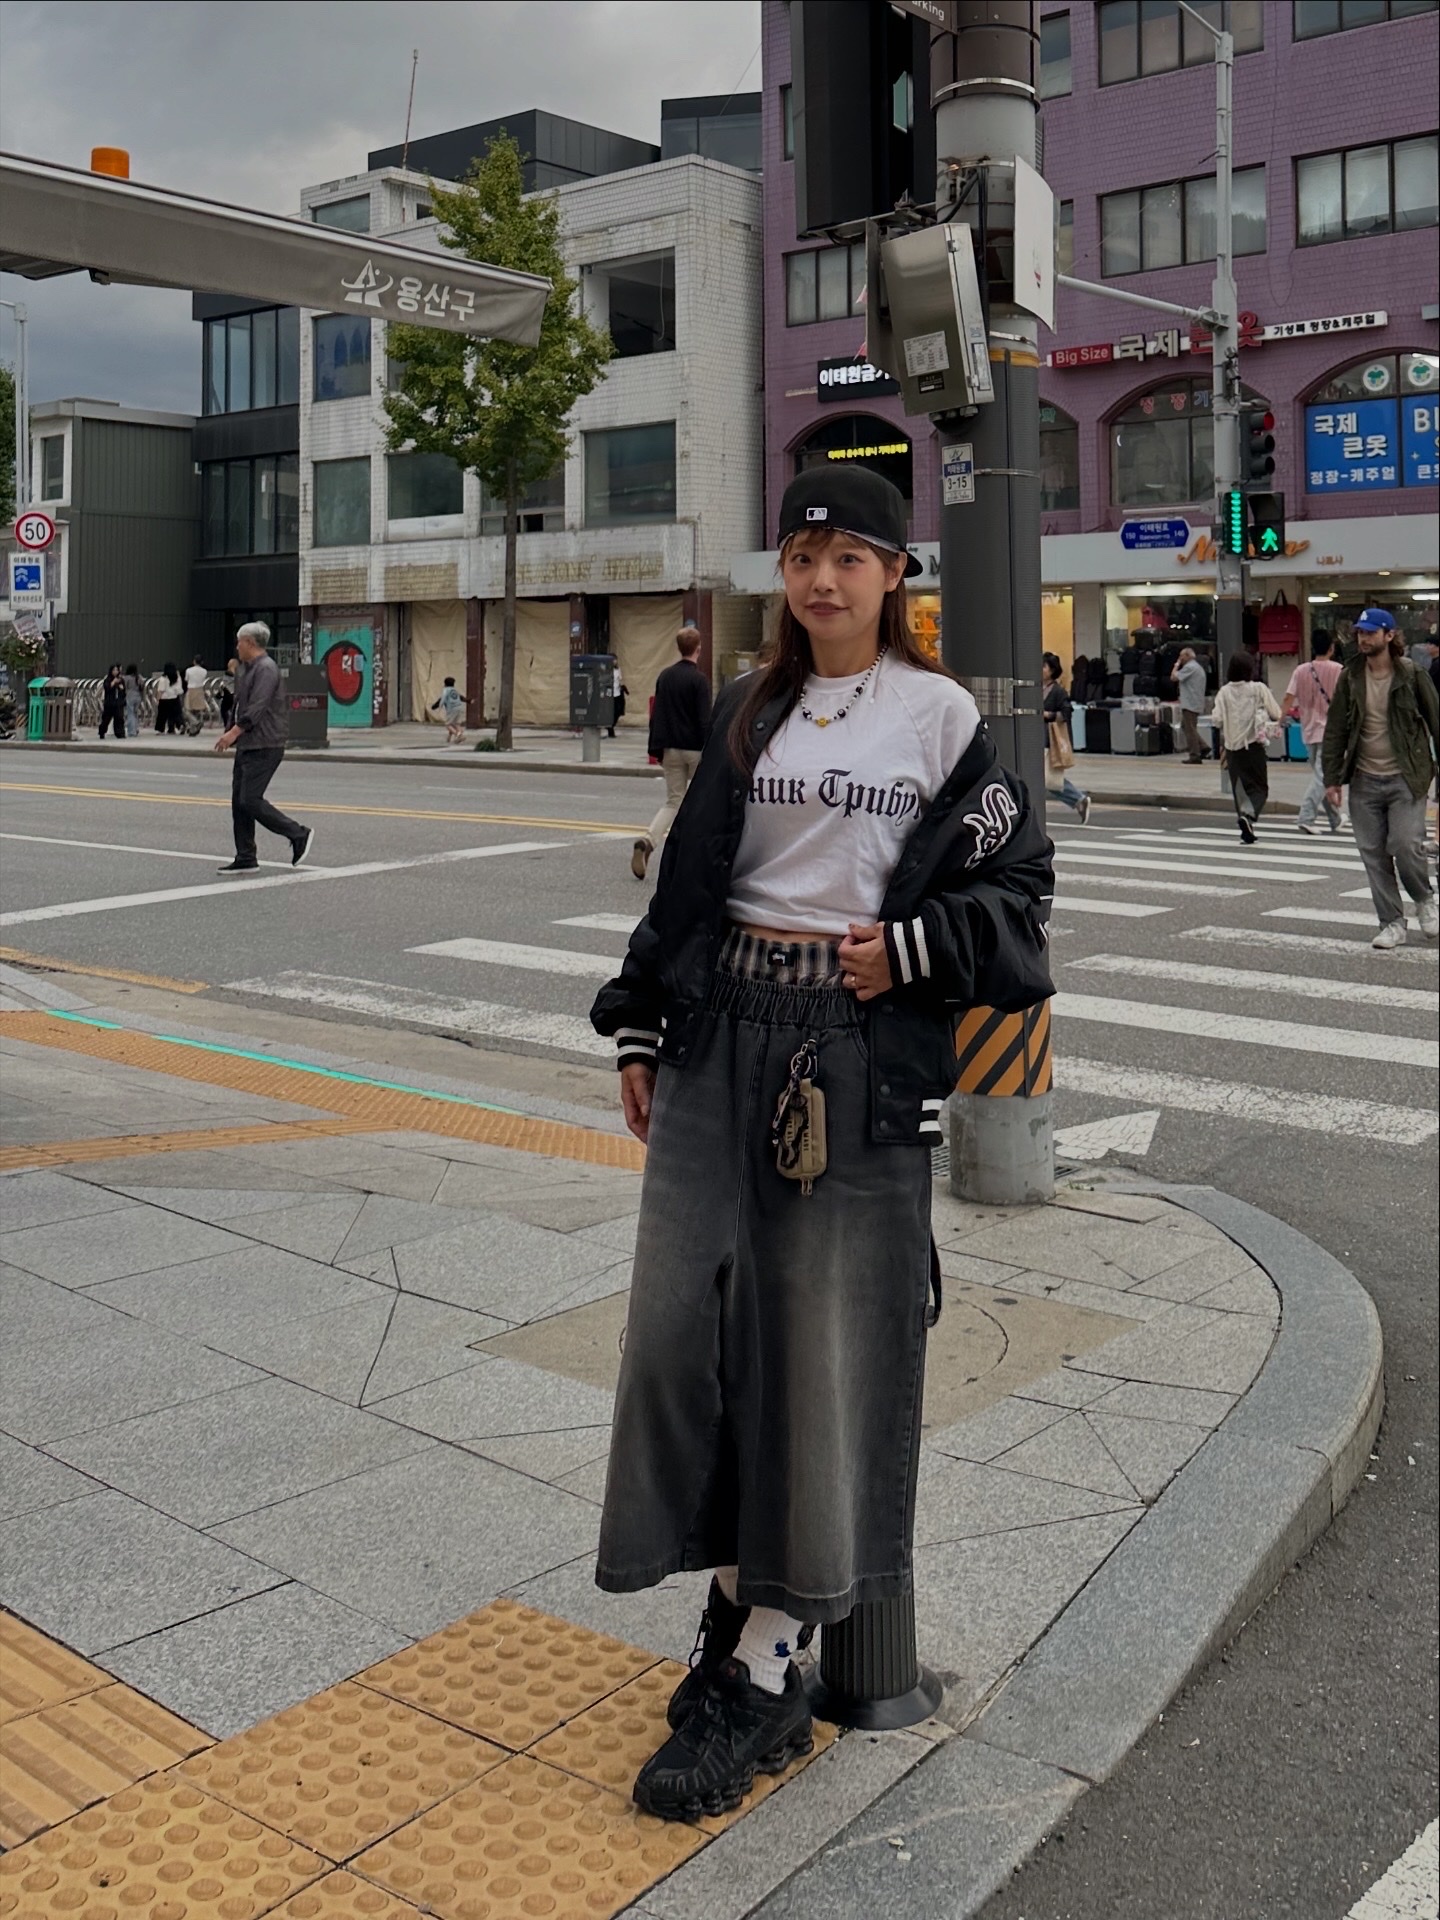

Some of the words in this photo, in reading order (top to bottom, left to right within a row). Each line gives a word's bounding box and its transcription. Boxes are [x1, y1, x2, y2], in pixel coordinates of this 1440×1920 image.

[397, 276, 476, 321] 용산구
[1119, 329, 1180, 361] 국제
[1055, 351, 1078, 366] Big
[1080, 347, 1109, 361] Size
[1314, 412, 1358, 435] 국제
[1343, 434, 1388, 459] 큰옷
[947, 476, 968, 490] 3-15
[1310, 466, 1395, 485] 정장-캐주얼
[25, 522, 46, 541] 50
